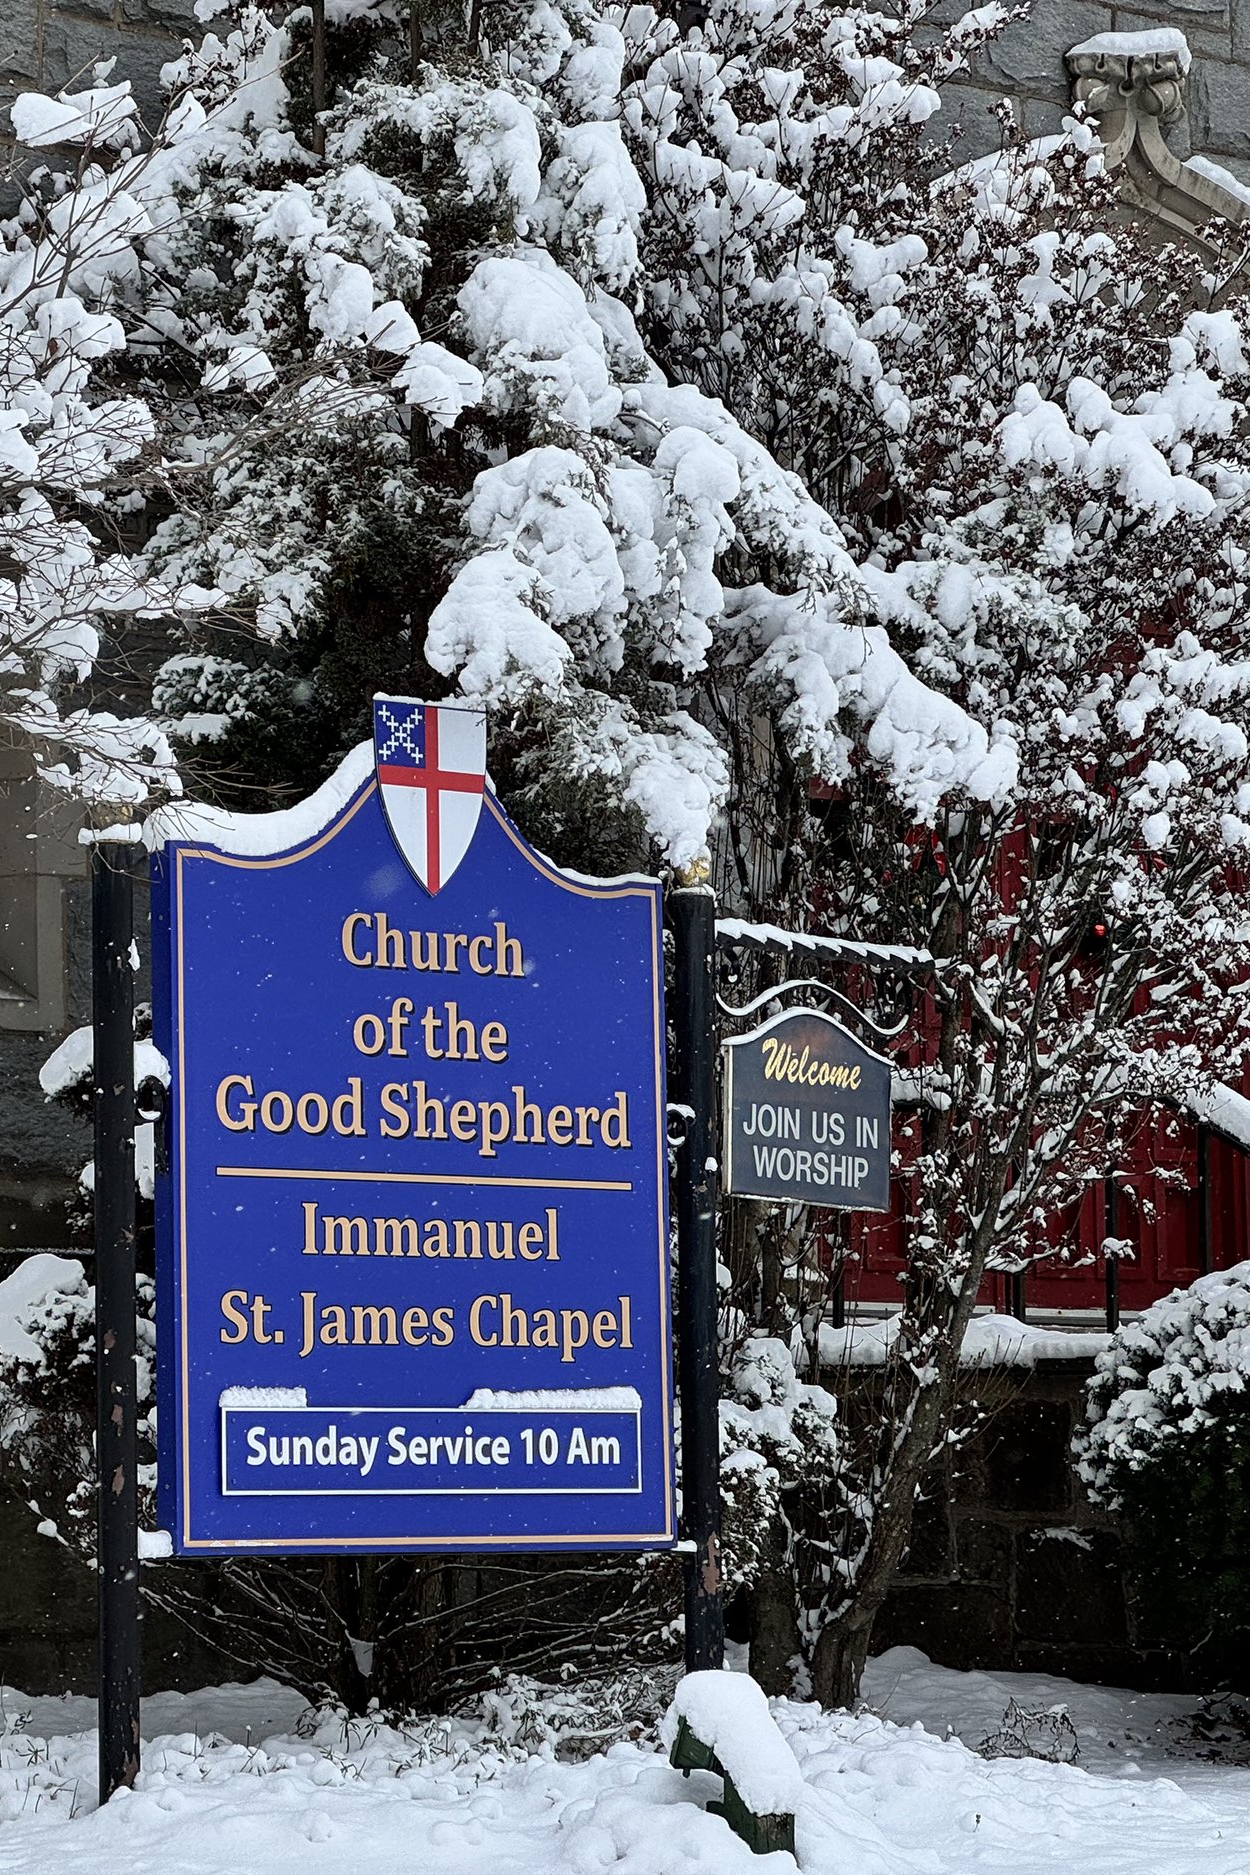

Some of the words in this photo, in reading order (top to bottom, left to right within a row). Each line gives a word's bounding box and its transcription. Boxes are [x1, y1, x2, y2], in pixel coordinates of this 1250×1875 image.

[341, 912, 525, 977] Church
[353, 997, 413, 1057] of
[421, 1001, 509, 1062] the
[761, 1037, 862, 1090] Welcome
[215, 1074, 367, 1137] Good
[379, 1080, 632, 1157] Shepherd
[742, 1103, 800, 1140] JOIN
[811, 1110, 846, 1146] US
[855, 1116, 879, 1149] IN
[752, 1145, 869, 1188] WORSHIP
[301, 1201, 561, 1261] Immanuel
[219, 1289, 285, 1345] St.
[298, 1291, 455, 1358] James
[468, 1293, 634, 1363] Chapel
[247, 1424, 380, 1477] Sunday
[387, 1426, 510, 1467] Service
[520, 1427, 559, 1465] 10
[566, 1427, 621, 1465] Am
